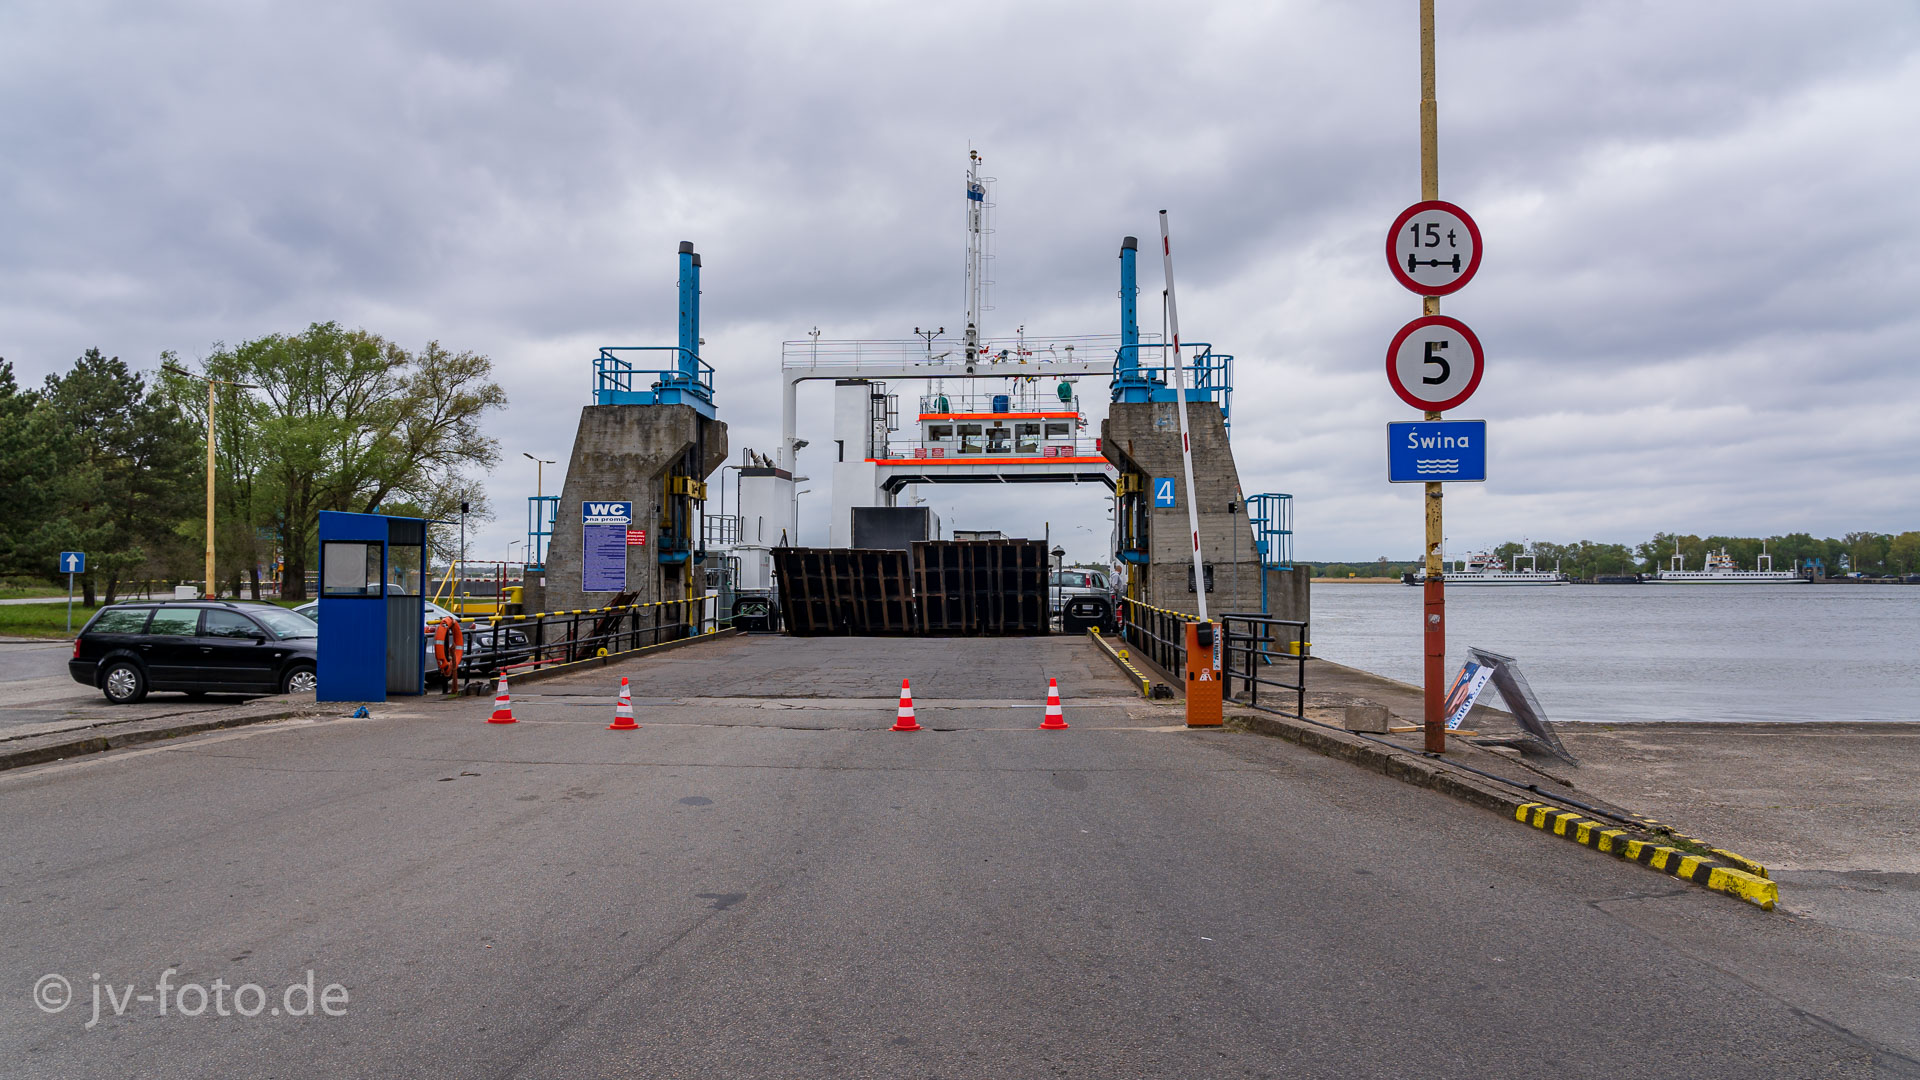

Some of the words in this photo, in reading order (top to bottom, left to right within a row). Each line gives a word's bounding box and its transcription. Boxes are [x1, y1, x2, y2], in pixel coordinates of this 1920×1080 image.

[1411, 223, 1441, 248] 15
[1447, 228, 1457, 248] t
[1422, 340, 1451, 385] 5
[1407, 427, 1470, 449] Świna
[1156, 480, 1174, 505] 4
[590, 504, 625, 516] WC
